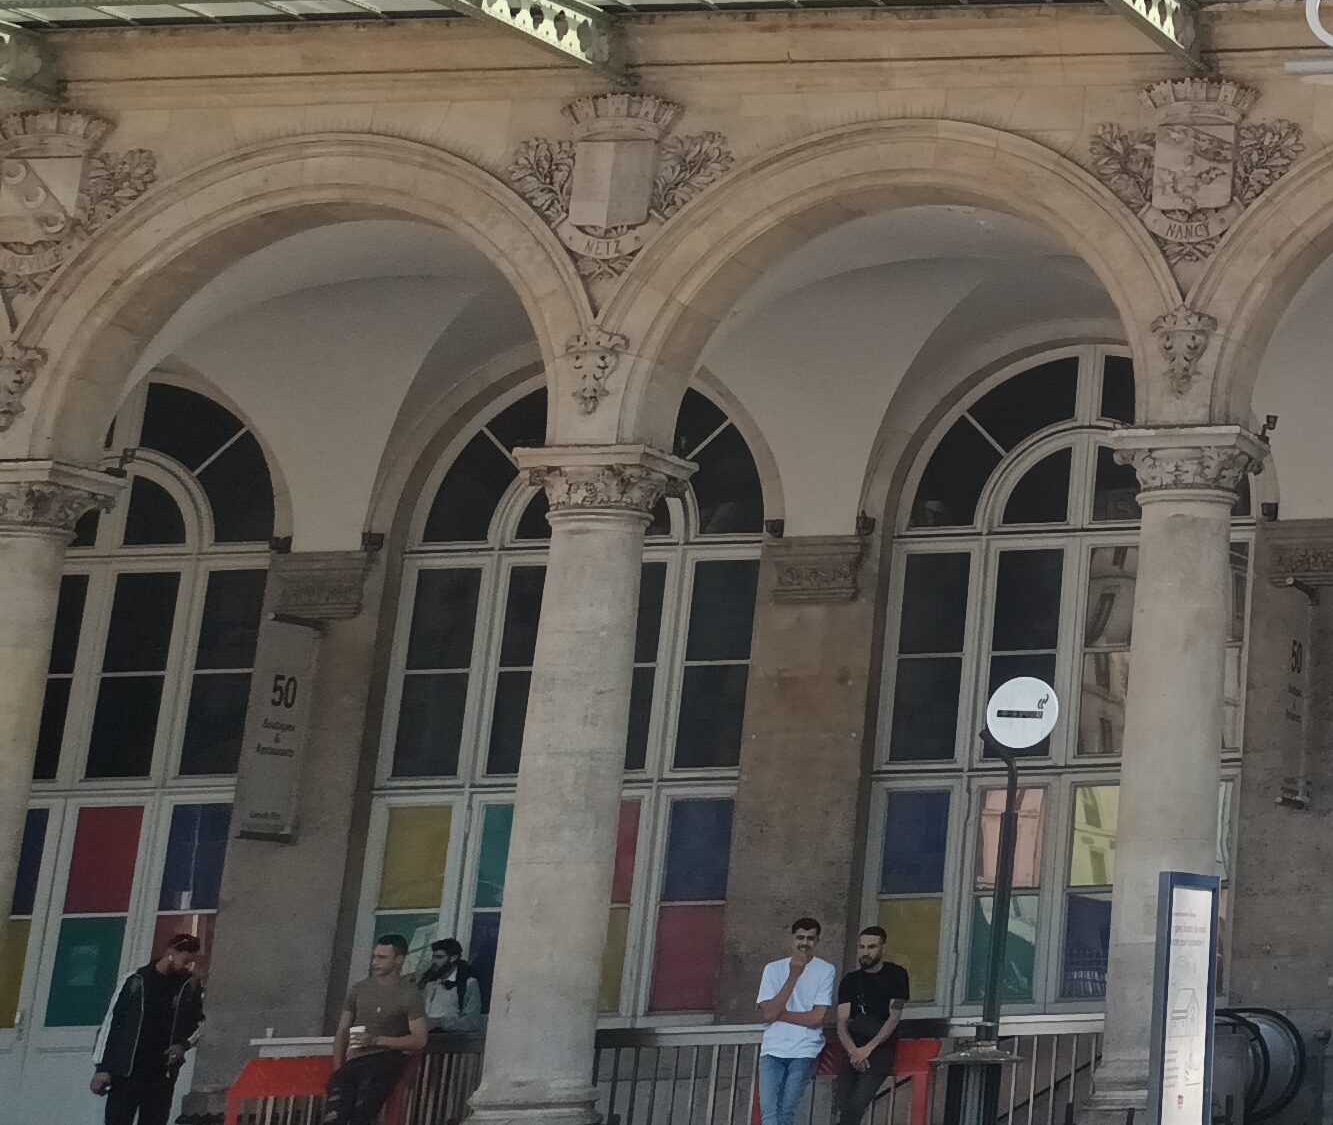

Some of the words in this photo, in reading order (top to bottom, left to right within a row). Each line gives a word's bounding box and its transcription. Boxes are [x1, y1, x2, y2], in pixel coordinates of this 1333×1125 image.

[1165, 221, 1211, 239] NANCY
[1291, 639, 1303, 674] 50
[271, 673, 298, 709] 50
